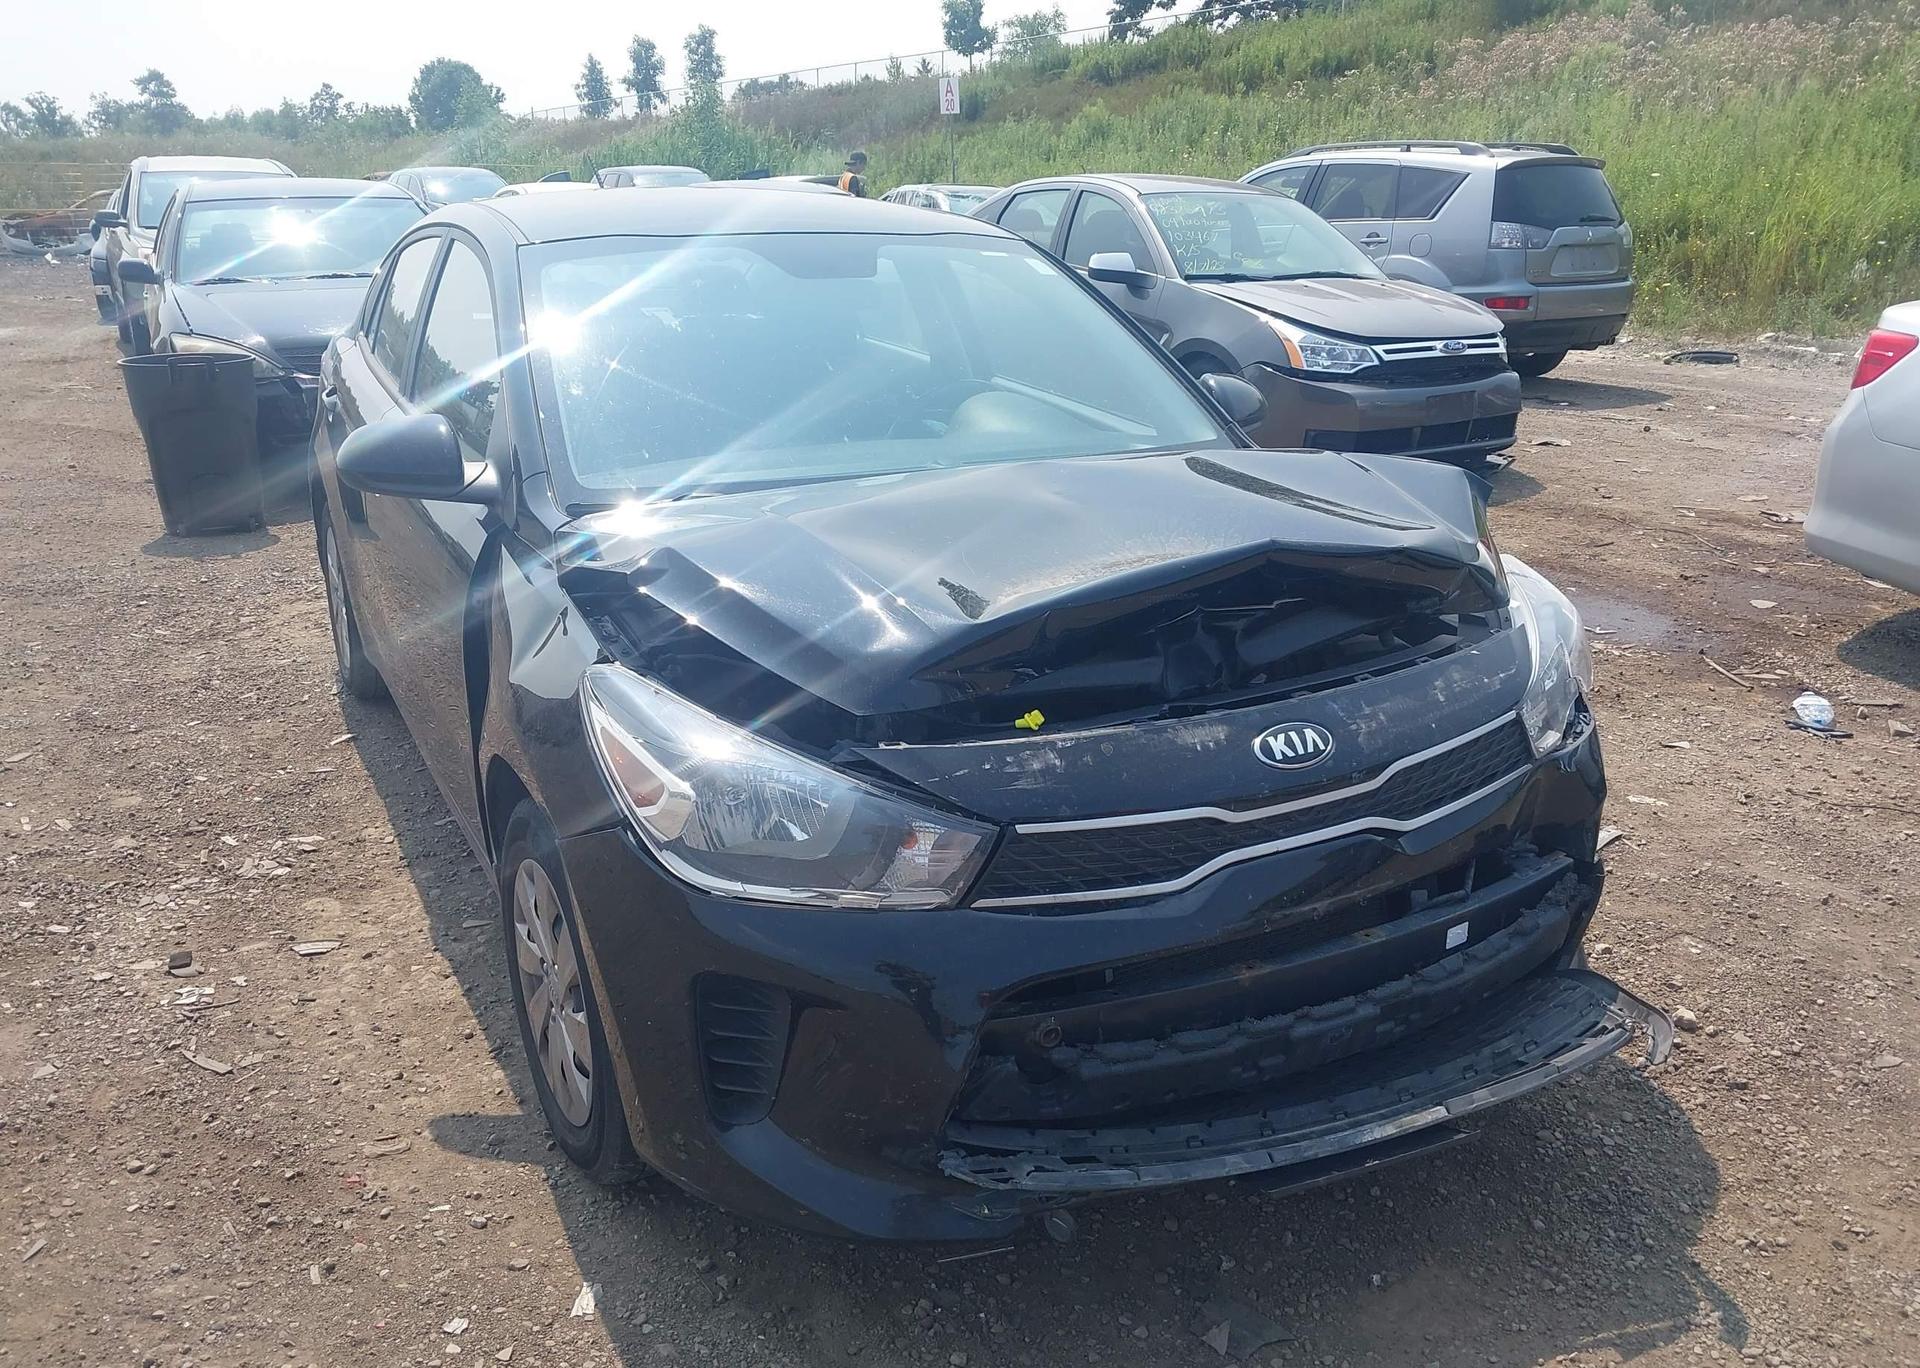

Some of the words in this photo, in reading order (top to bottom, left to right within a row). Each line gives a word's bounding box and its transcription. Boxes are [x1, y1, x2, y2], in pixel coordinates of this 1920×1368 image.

[945, 79, 954, 97] A
[945, 98, 955, 111] 20
[1265, 728, 1326, 760] KIA
